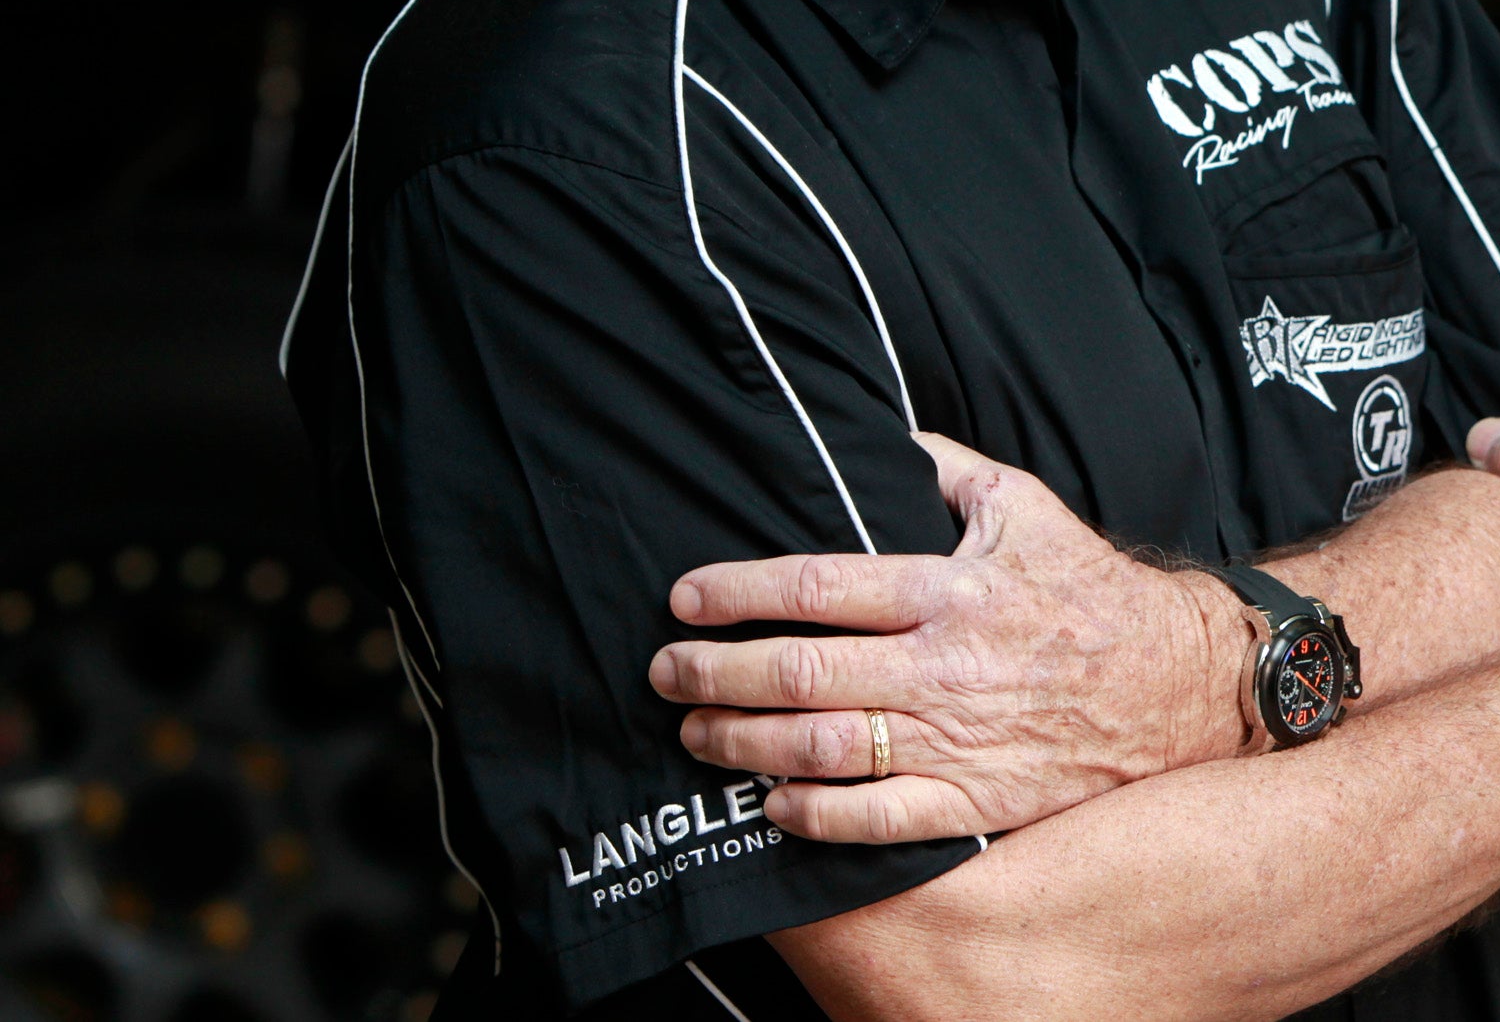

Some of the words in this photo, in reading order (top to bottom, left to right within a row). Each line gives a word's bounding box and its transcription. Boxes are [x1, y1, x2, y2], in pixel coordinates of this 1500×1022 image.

[1146, 19, 1342, 138] COPS
[1182, 105, 1299, 186] Racing
[591, 827, 784, 909] PRODUCTIONS
